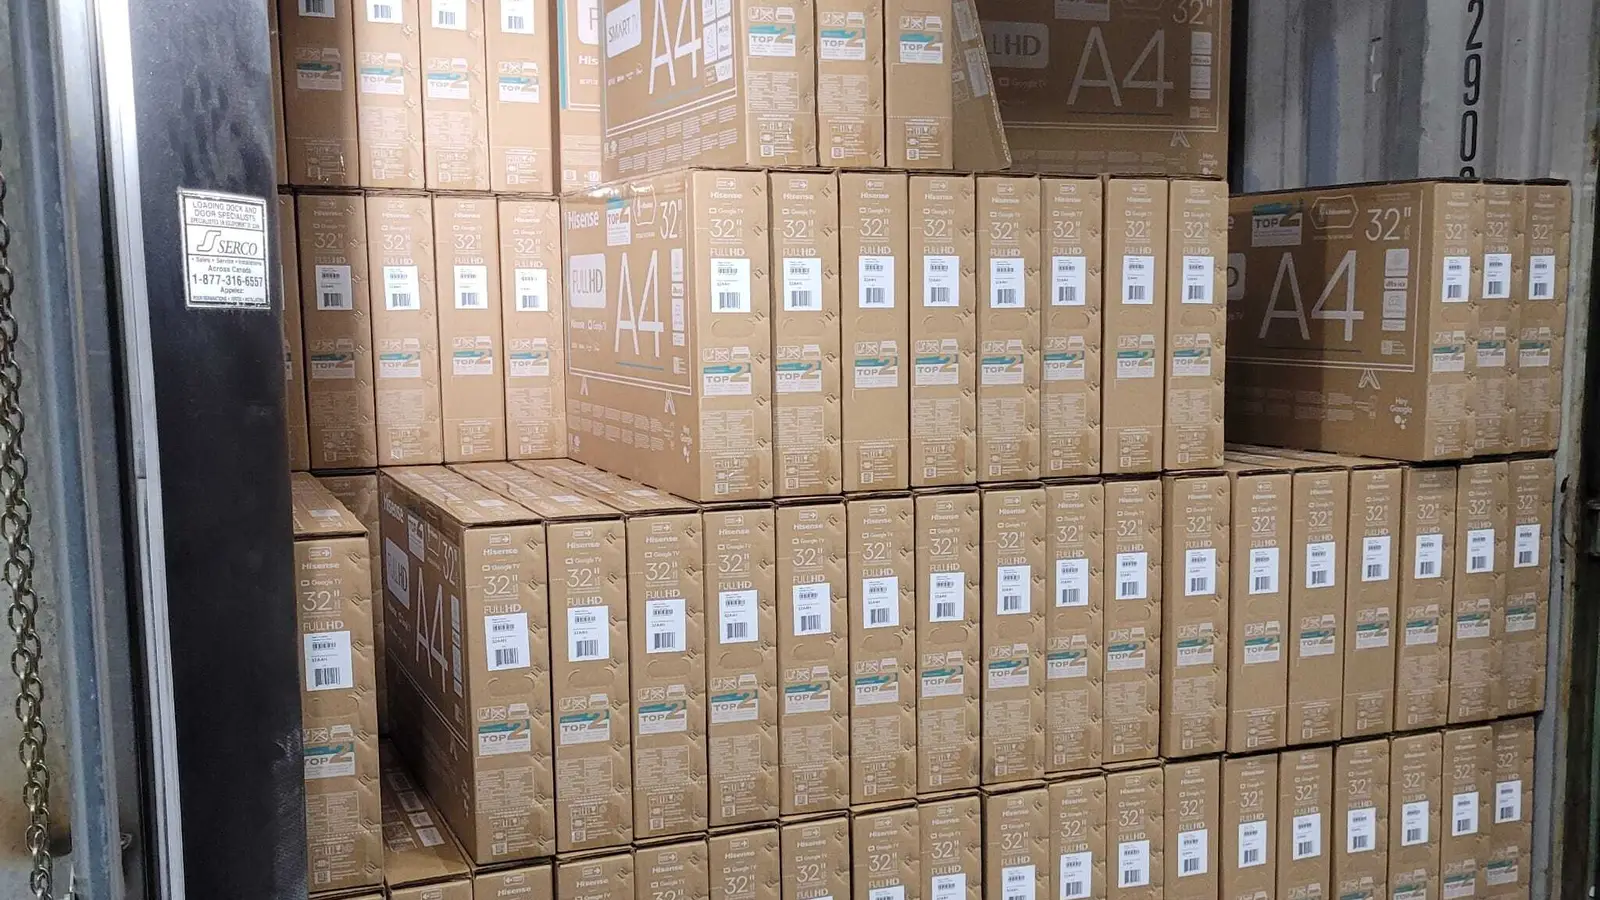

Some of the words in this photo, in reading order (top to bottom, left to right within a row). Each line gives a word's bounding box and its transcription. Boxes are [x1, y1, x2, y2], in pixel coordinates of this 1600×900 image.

[649, 0, 701, 94] A4
[1066, 27, 1174, 107] A4
[193, 201, 224, 211] LOADING
[225, 204, 244, 213] DOCK
[244, 206, 257, 214] AND
[194, 209, 216, 218] DOOR
[218, 212, 256, 222] SPECIALISTS
[568, 211, 599, 229] Hisense
[1365, 207, 1412, 242] 32"
[217, 241, 257, 256] SERCO
[208, 265, 231, 273] Across
[231, 266, 252, 274] Canada
[192, 274, 263, 288] 1-877-316-6557
[1259, 250, 1364, 342] A4
[614, 249, 664, 358] A4
[567, 541, 600, 549] Hisense
[483, 548, 518, 556] Hisense
[416, 567, 448, 693] A4
[724, 851, 755, 859] Hisense
[652, 865, 683, 873] Hisense
[576, 879, 608, 888] Hisense
[498, 886, 531, 897] Hisense
